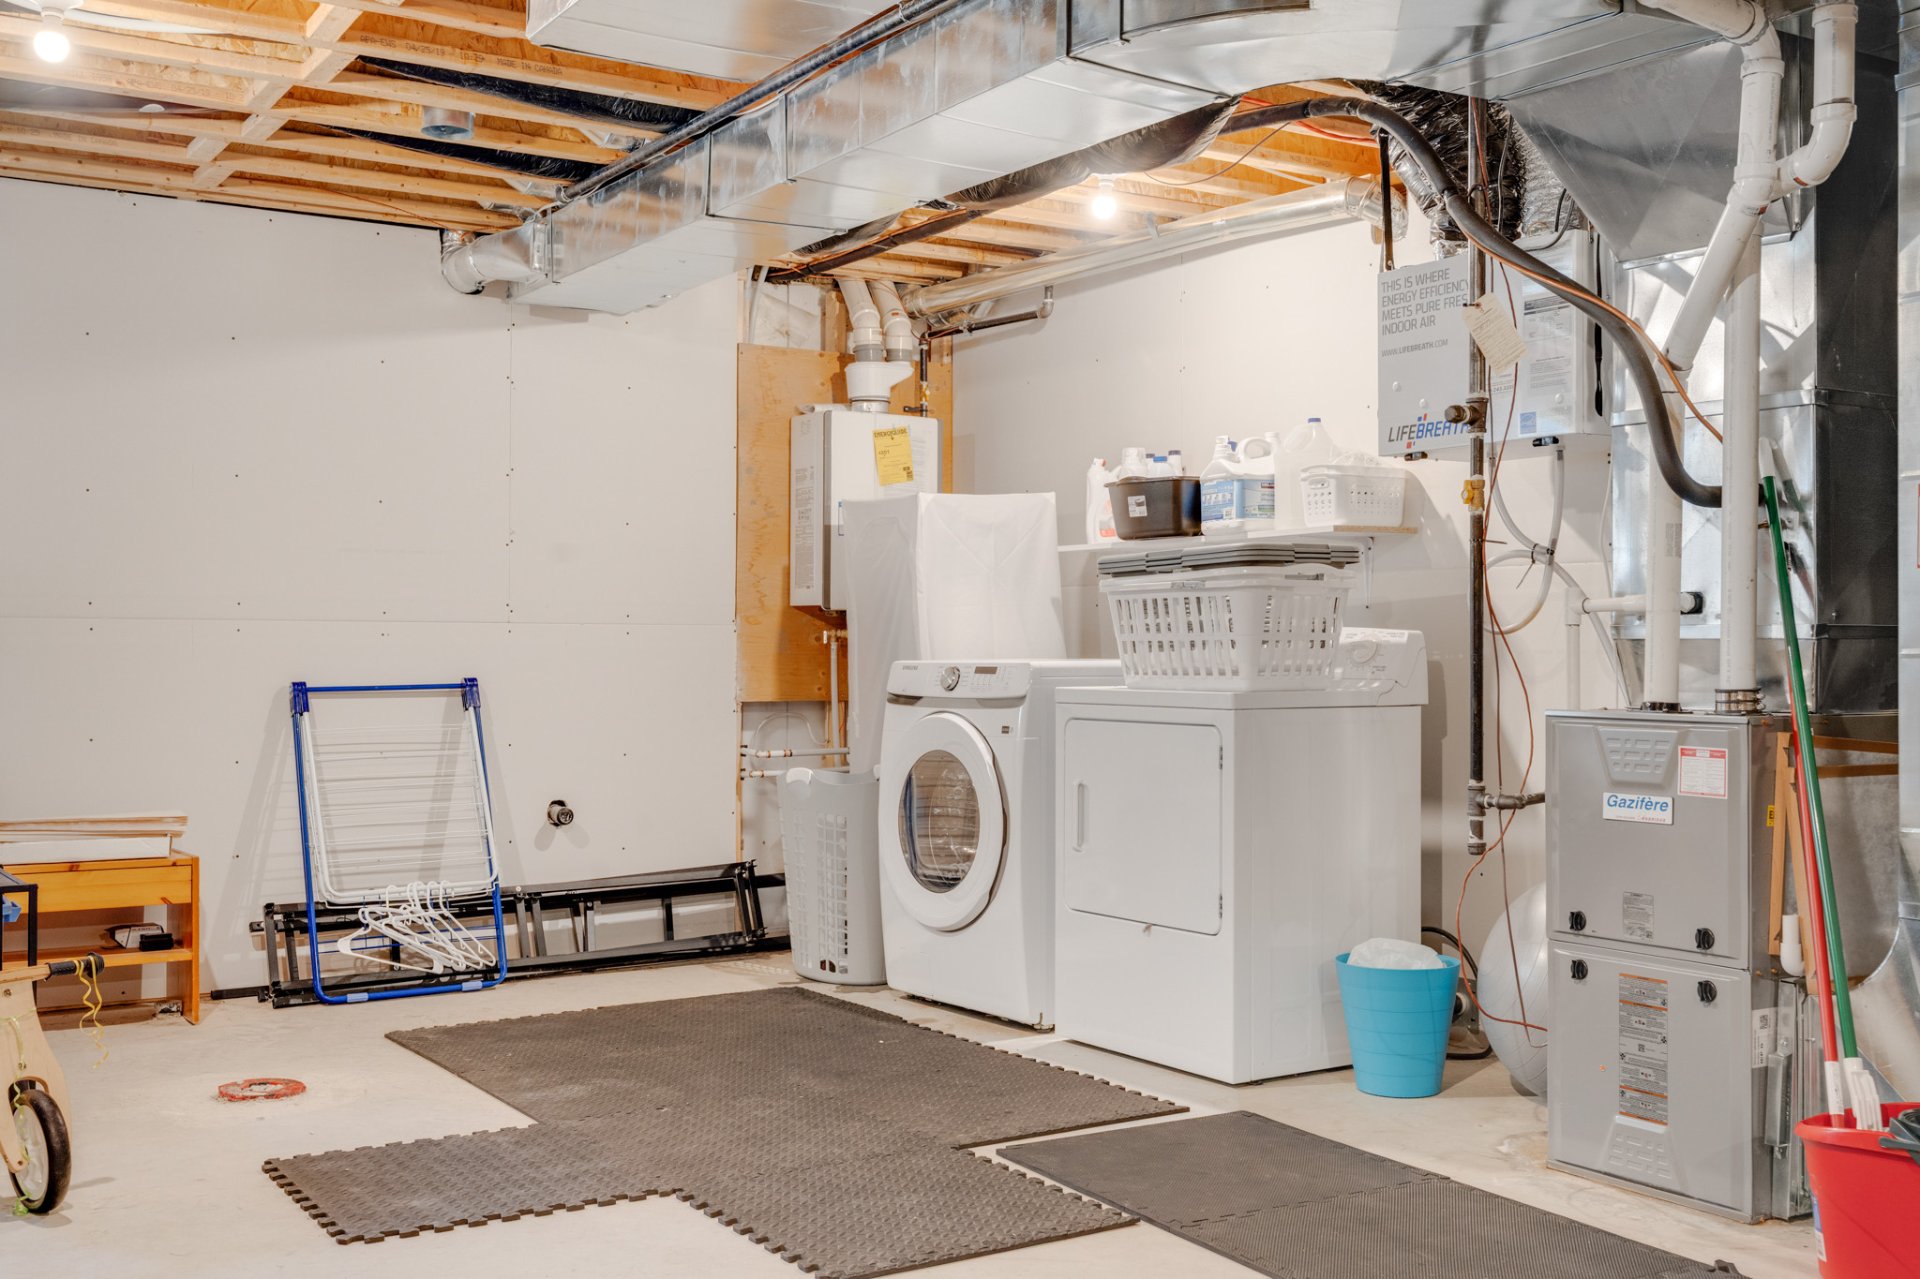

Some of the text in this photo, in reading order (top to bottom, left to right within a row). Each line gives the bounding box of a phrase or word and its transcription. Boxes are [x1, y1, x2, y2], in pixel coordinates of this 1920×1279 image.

[521, 62, 531, 71] IN
[1382, 267, 1450, 293] THIS IS WHERE
[1382, 289, 1418, 308] ENERGY
[1382, 293, 1468, 322] MEETS PURE FRES
[1382, 314, 1436, 336] INDOOR AIR
[1382, 338, 1448, 357] WWW.LIFEBREATH.COM
[1606, 794, 1669, 812] Gazifère
